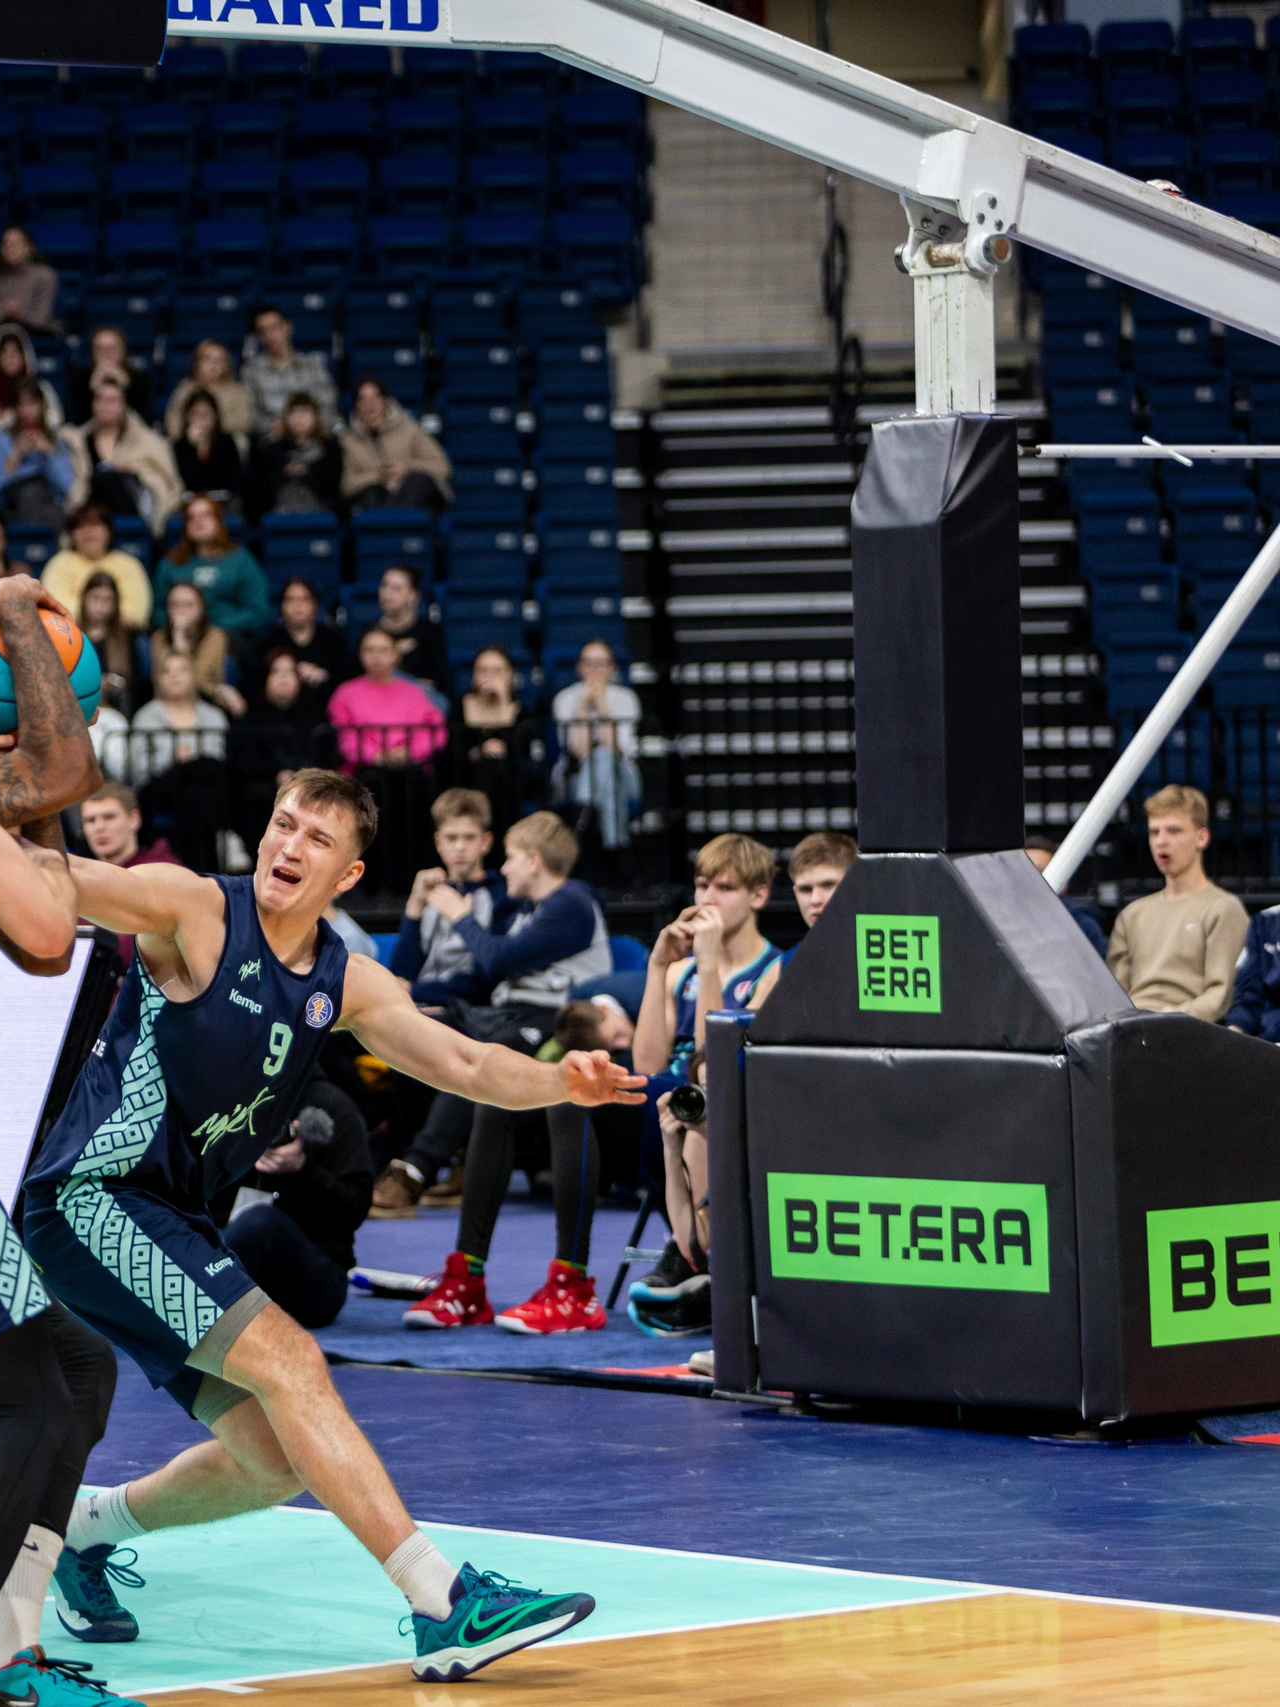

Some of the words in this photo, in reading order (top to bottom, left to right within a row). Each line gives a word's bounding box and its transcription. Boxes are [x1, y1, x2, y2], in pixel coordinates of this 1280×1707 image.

[866, 929, 929, 960] BET
[262, 1022, 294, 1076] 9
[1170, 1232, 1280, 1313] BE
